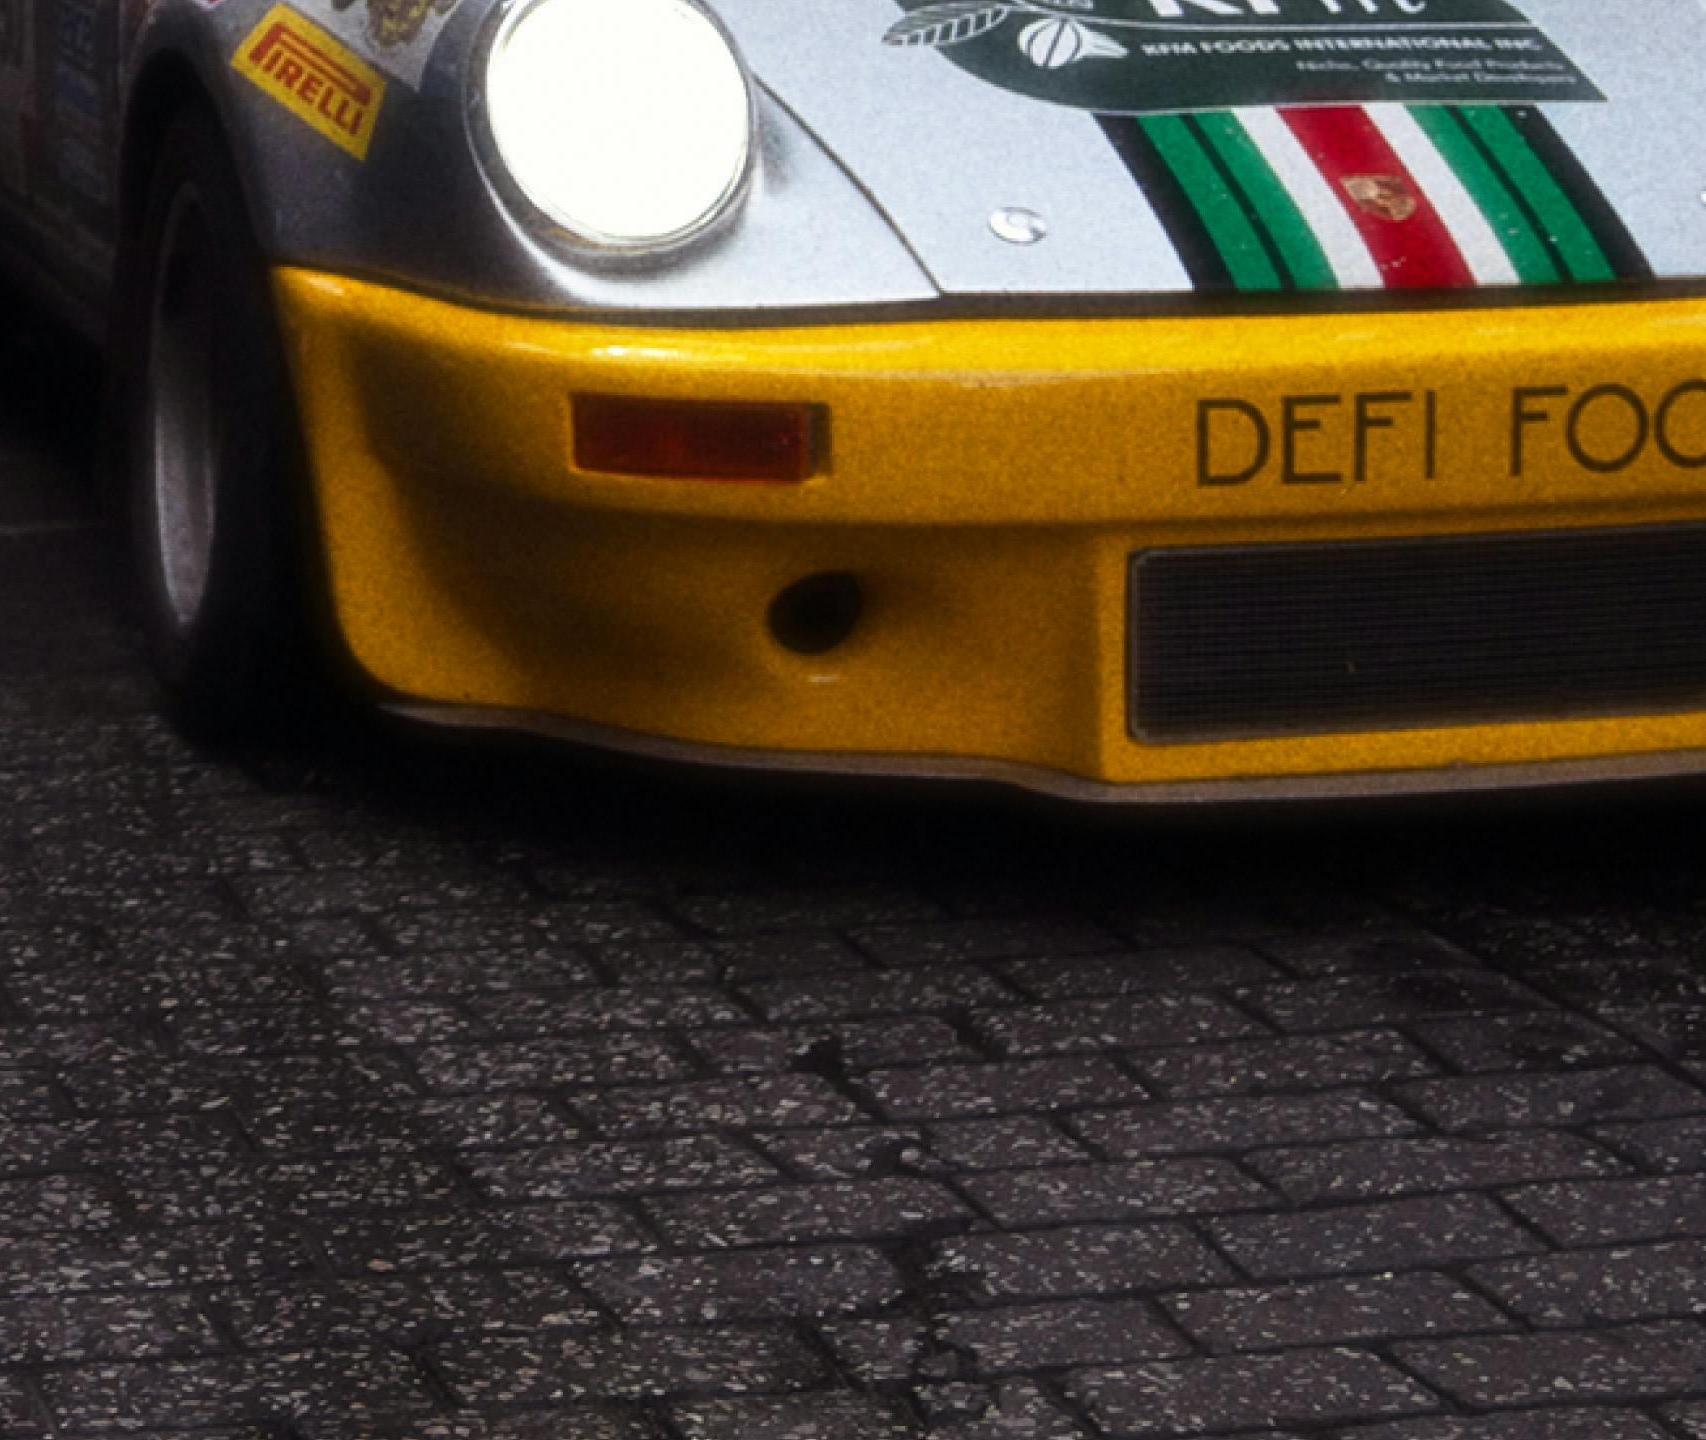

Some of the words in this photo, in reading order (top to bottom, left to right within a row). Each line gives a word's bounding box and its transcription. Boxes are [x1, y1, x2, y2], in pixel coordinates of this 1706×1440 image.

[250, 22, 371, 136] PIRELLI
[1199, 39, 1290, 54] FOODS
[1293, 36, 1492, 52] INTERNATIONAL
[1195, 390, 1437, 486] DEFI
